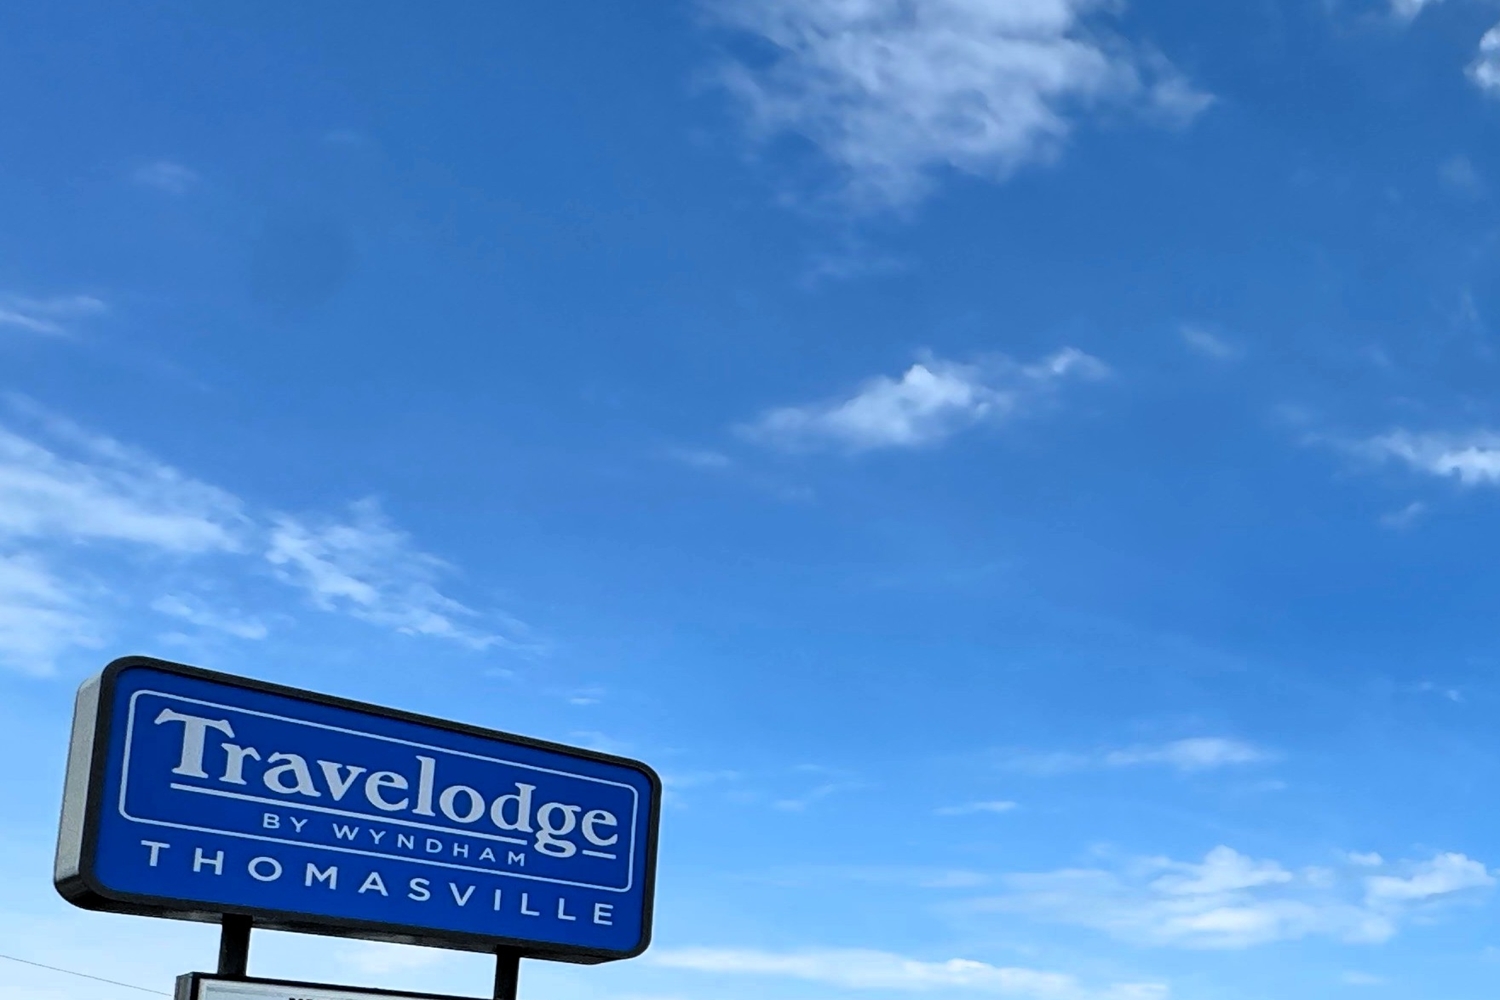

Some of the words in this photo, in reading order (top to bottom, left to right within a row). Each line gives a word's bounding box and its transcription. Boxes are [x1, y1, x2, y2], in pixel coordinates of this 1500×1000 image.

[154, 708, 619, 858] Travelodge
[141, 840, 614, 926] THOMASVILLE
[262, 813, 308, 833] BY
[332, 823, 526, 867] WYNDHAM
